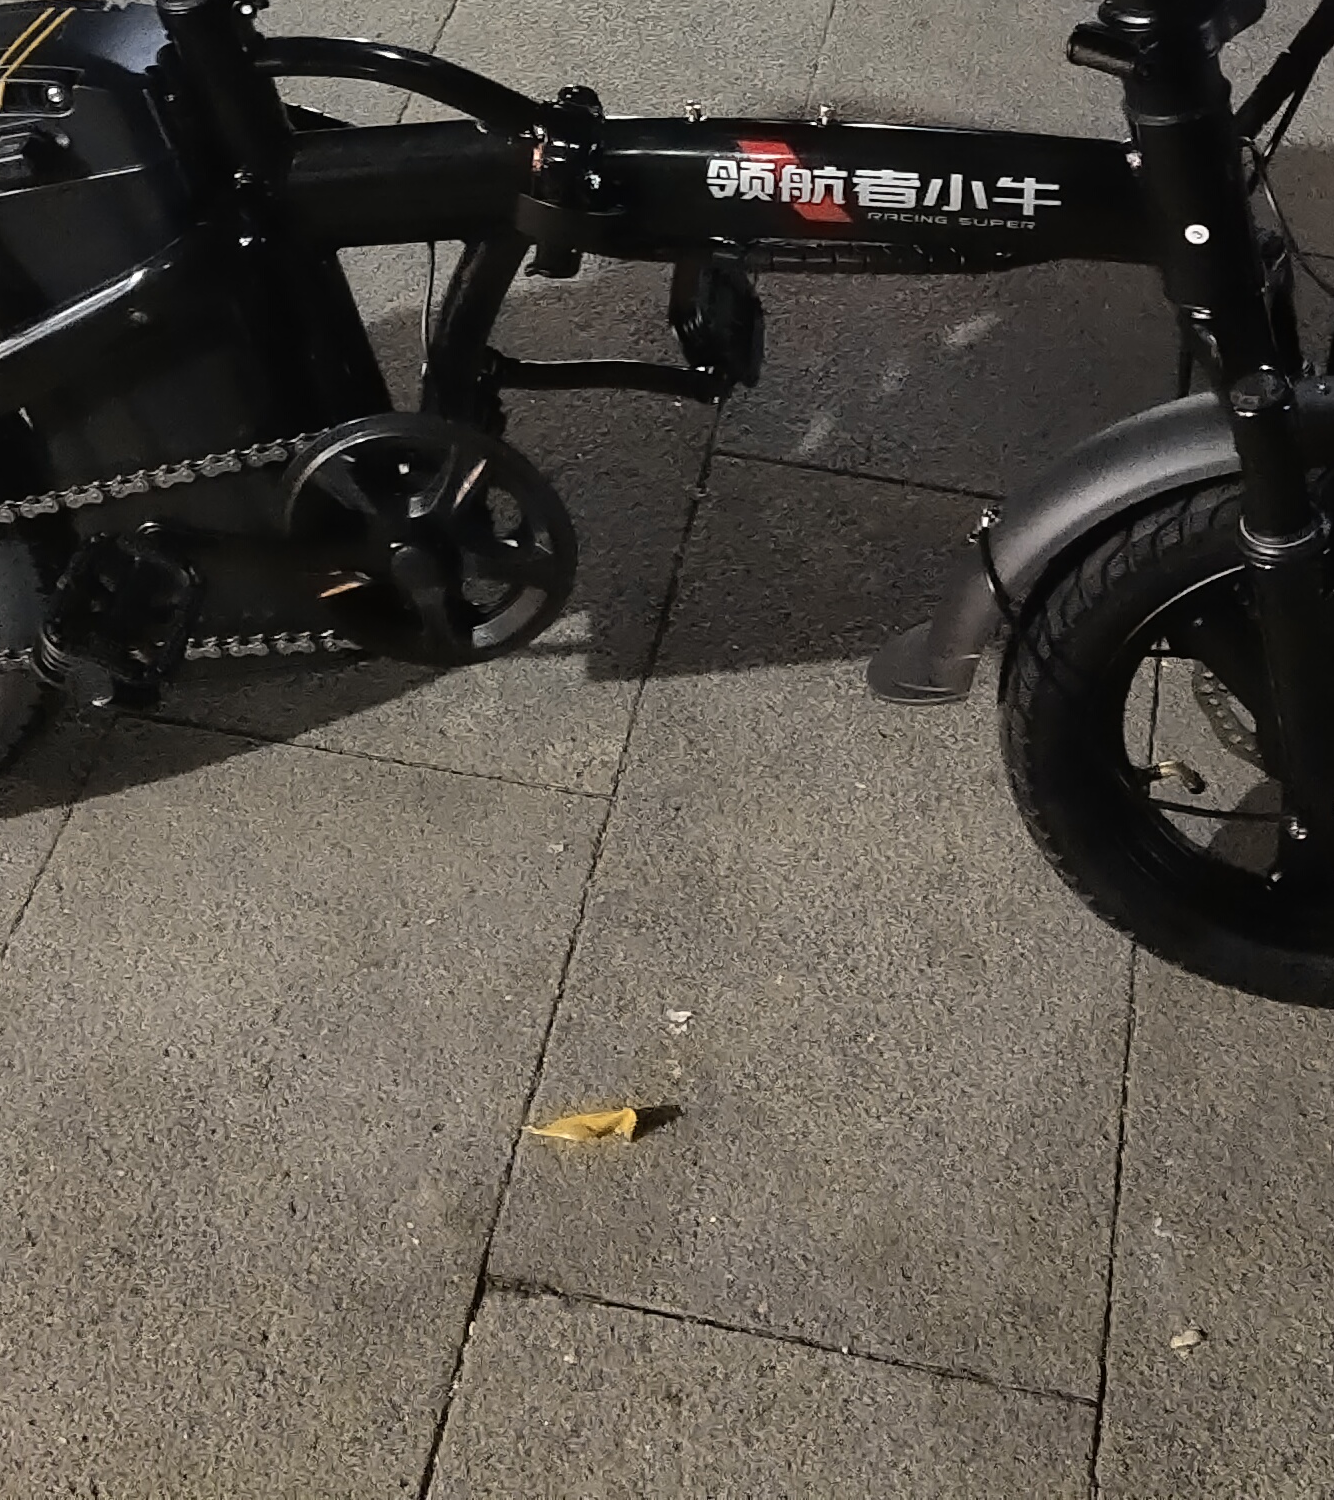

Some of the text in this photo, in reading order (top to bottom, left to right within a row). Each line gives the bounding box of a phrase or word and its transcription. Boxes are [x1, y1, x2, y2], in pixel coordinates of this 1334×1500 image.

[706, 159, 1062, 216] 领航者小牛
[867, 211, 1036, 230] RACING SUPER
